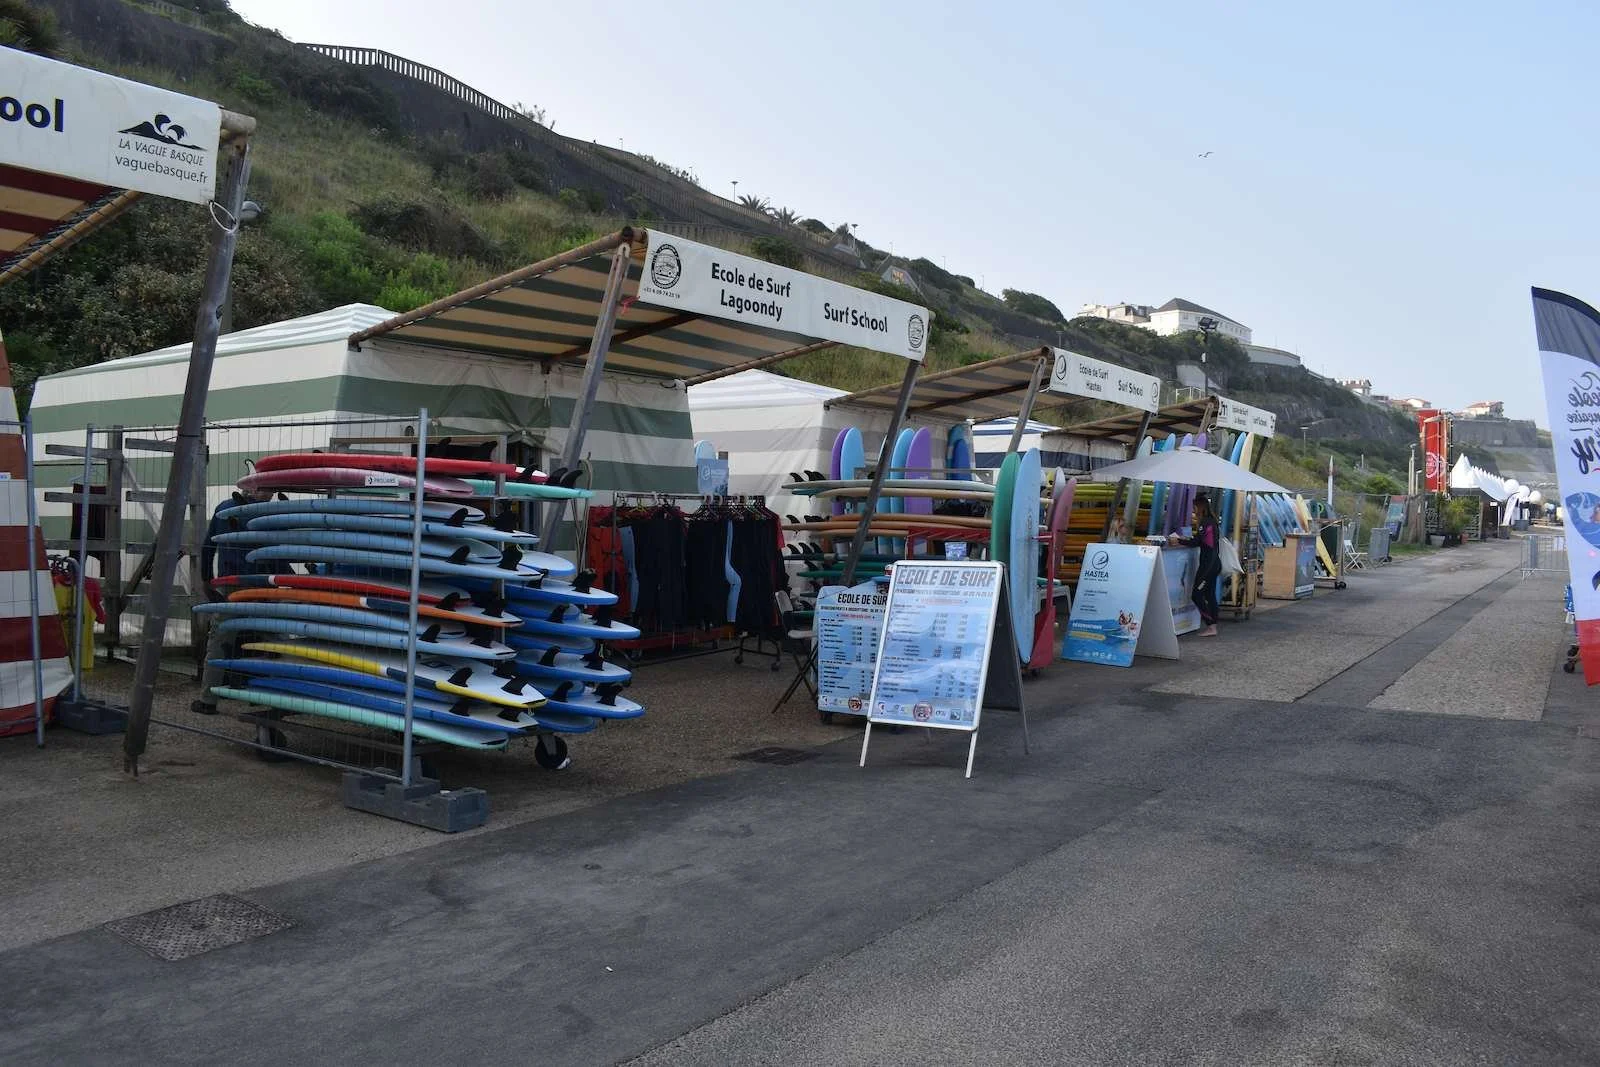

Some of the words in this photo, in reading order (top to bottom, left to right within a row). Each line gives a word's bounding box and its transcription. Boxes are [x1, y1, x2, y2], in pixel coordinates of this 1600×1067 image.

[118, 138, 130, 150] LA
[135, 142, 168, 158] VAGUE
[170, 149, 204, 167] BASQUE
[115, 155, 209, 185] vaguebasque.fr
[711, 262, 745, 287] Ecole
[748, 271, 764, 292] de
[766, 277, 792, 298] Surf
[720, 289, 783, 322] Lagoondy
[824, 302, 850, 324] Surf
[851, 309, 888, 333] School
[1118, 379, 1128, 392] Surf
[1128, 382, 1143, 397] School
[939, 570, 959, 586] DE
[960, 571, 996, 588] SURF
[1084, 569, 1109, 578] HASTEA
[837, 593, 861, 604] ECOLE
[861, 594, 871, 605] DE
[872, 595, 888, 606] SUR
